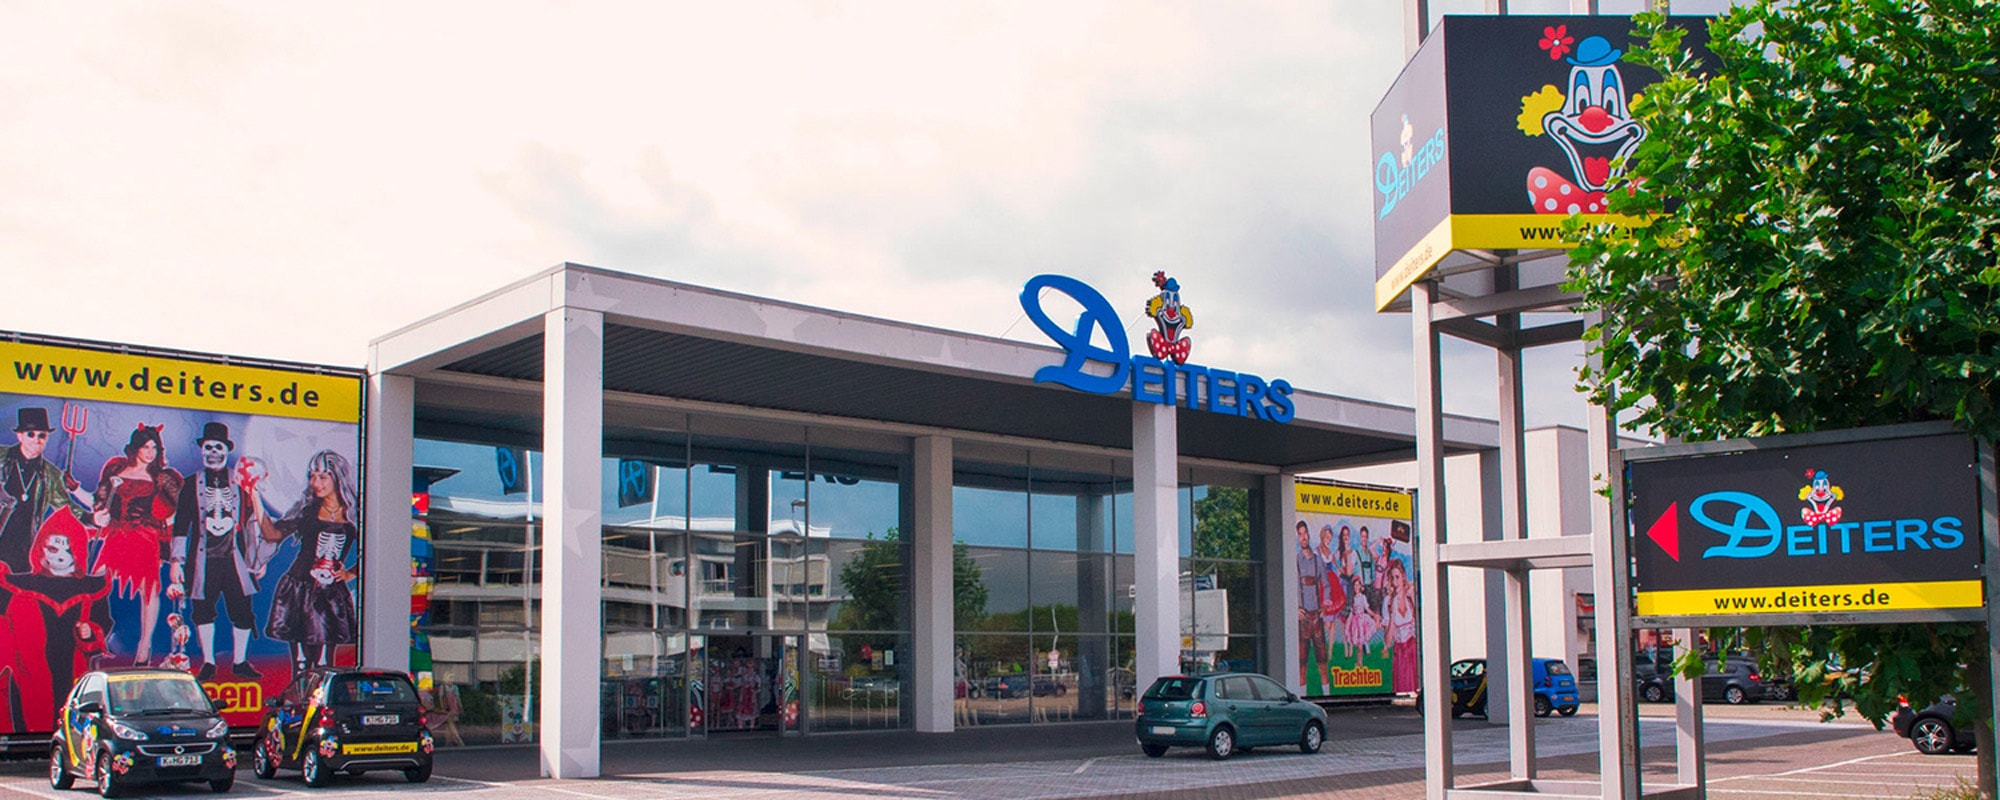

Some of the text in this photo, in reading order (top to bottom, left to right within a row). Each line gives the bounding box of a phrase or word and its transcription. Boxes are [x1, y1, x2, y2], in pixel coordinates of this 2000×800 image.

[1375, 127, 1445, 222] DEITERS
[1019, 274, 1295, 423] DEITERS
[14, 361, 319, 407] www.deiters.de
[1300, 491, 1399, 512] www.deiters.de
[1689, 490, 1964, 559] DEITERS
[1714, 589, 1890, 609] www.deiters.de
[1332, 667, 1382, 687] Trachten
[353, 740, 410, 752] www.deiters.de
